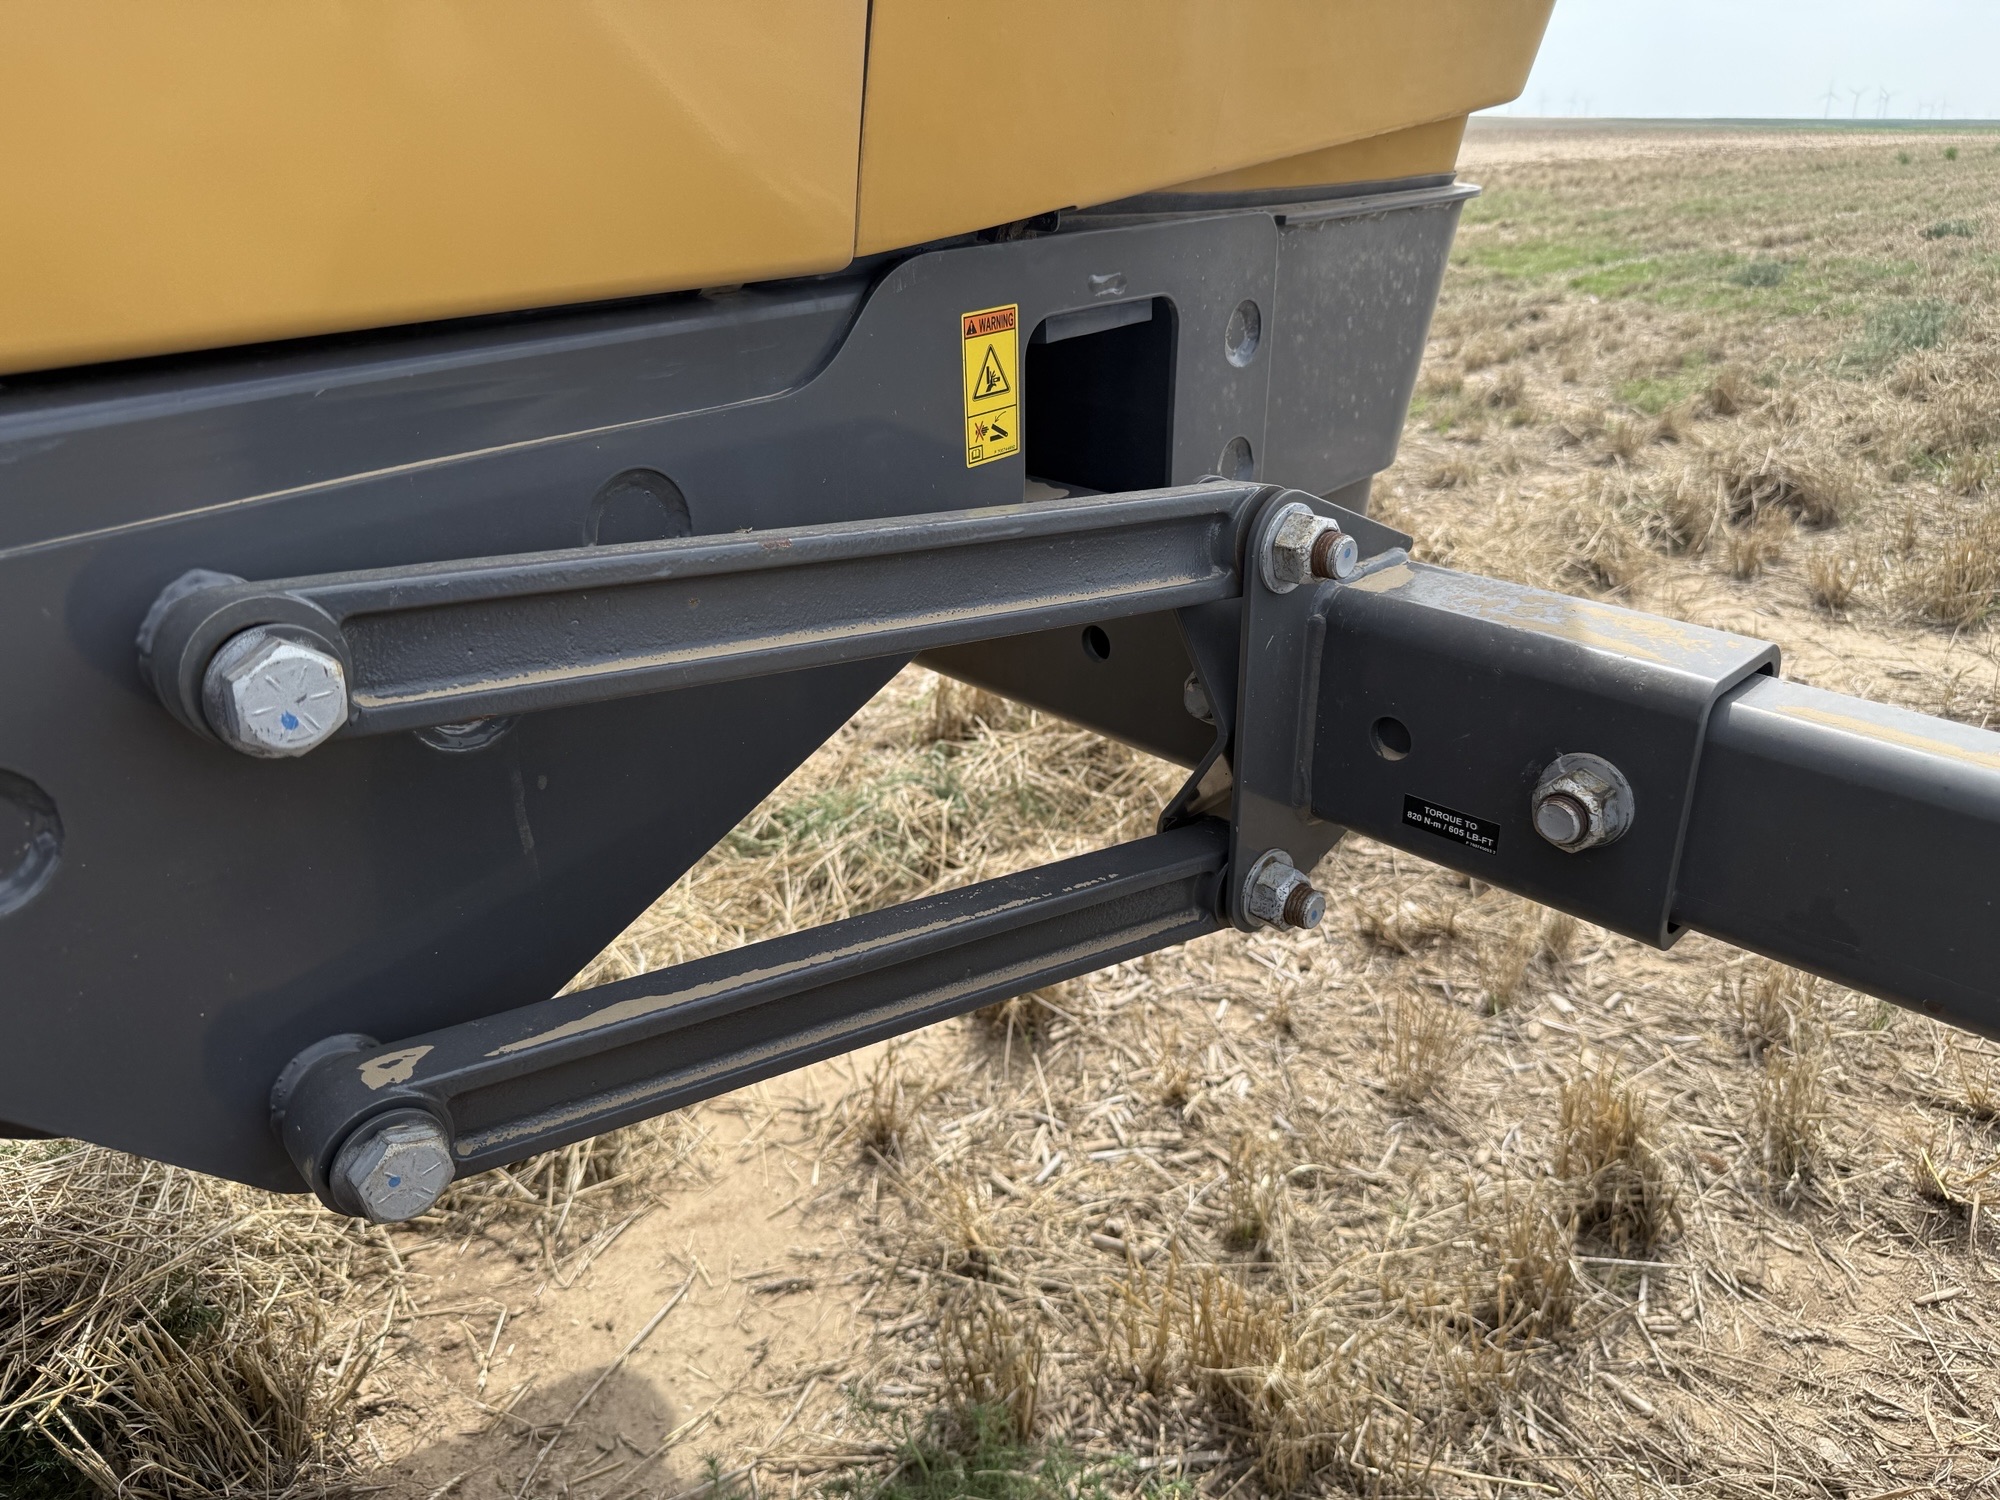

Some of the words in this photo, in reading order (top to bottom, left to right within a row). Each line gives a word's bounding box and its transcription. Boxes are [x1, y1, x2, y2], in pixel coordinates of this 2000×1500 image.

[978, 312, 1014, 334] WARNING
[1407, 810, 1422, 822] 820
[1424, 816, 1442, 829] N-m
[1443, 823, 1447, 831] /
[1448, 825, 1465, 837] 605
[1466, 831, 1494, 847] LB-FT
[1424, 806, 1463, 826] TORQUE
[1465, 820, 1478, 831] TO
